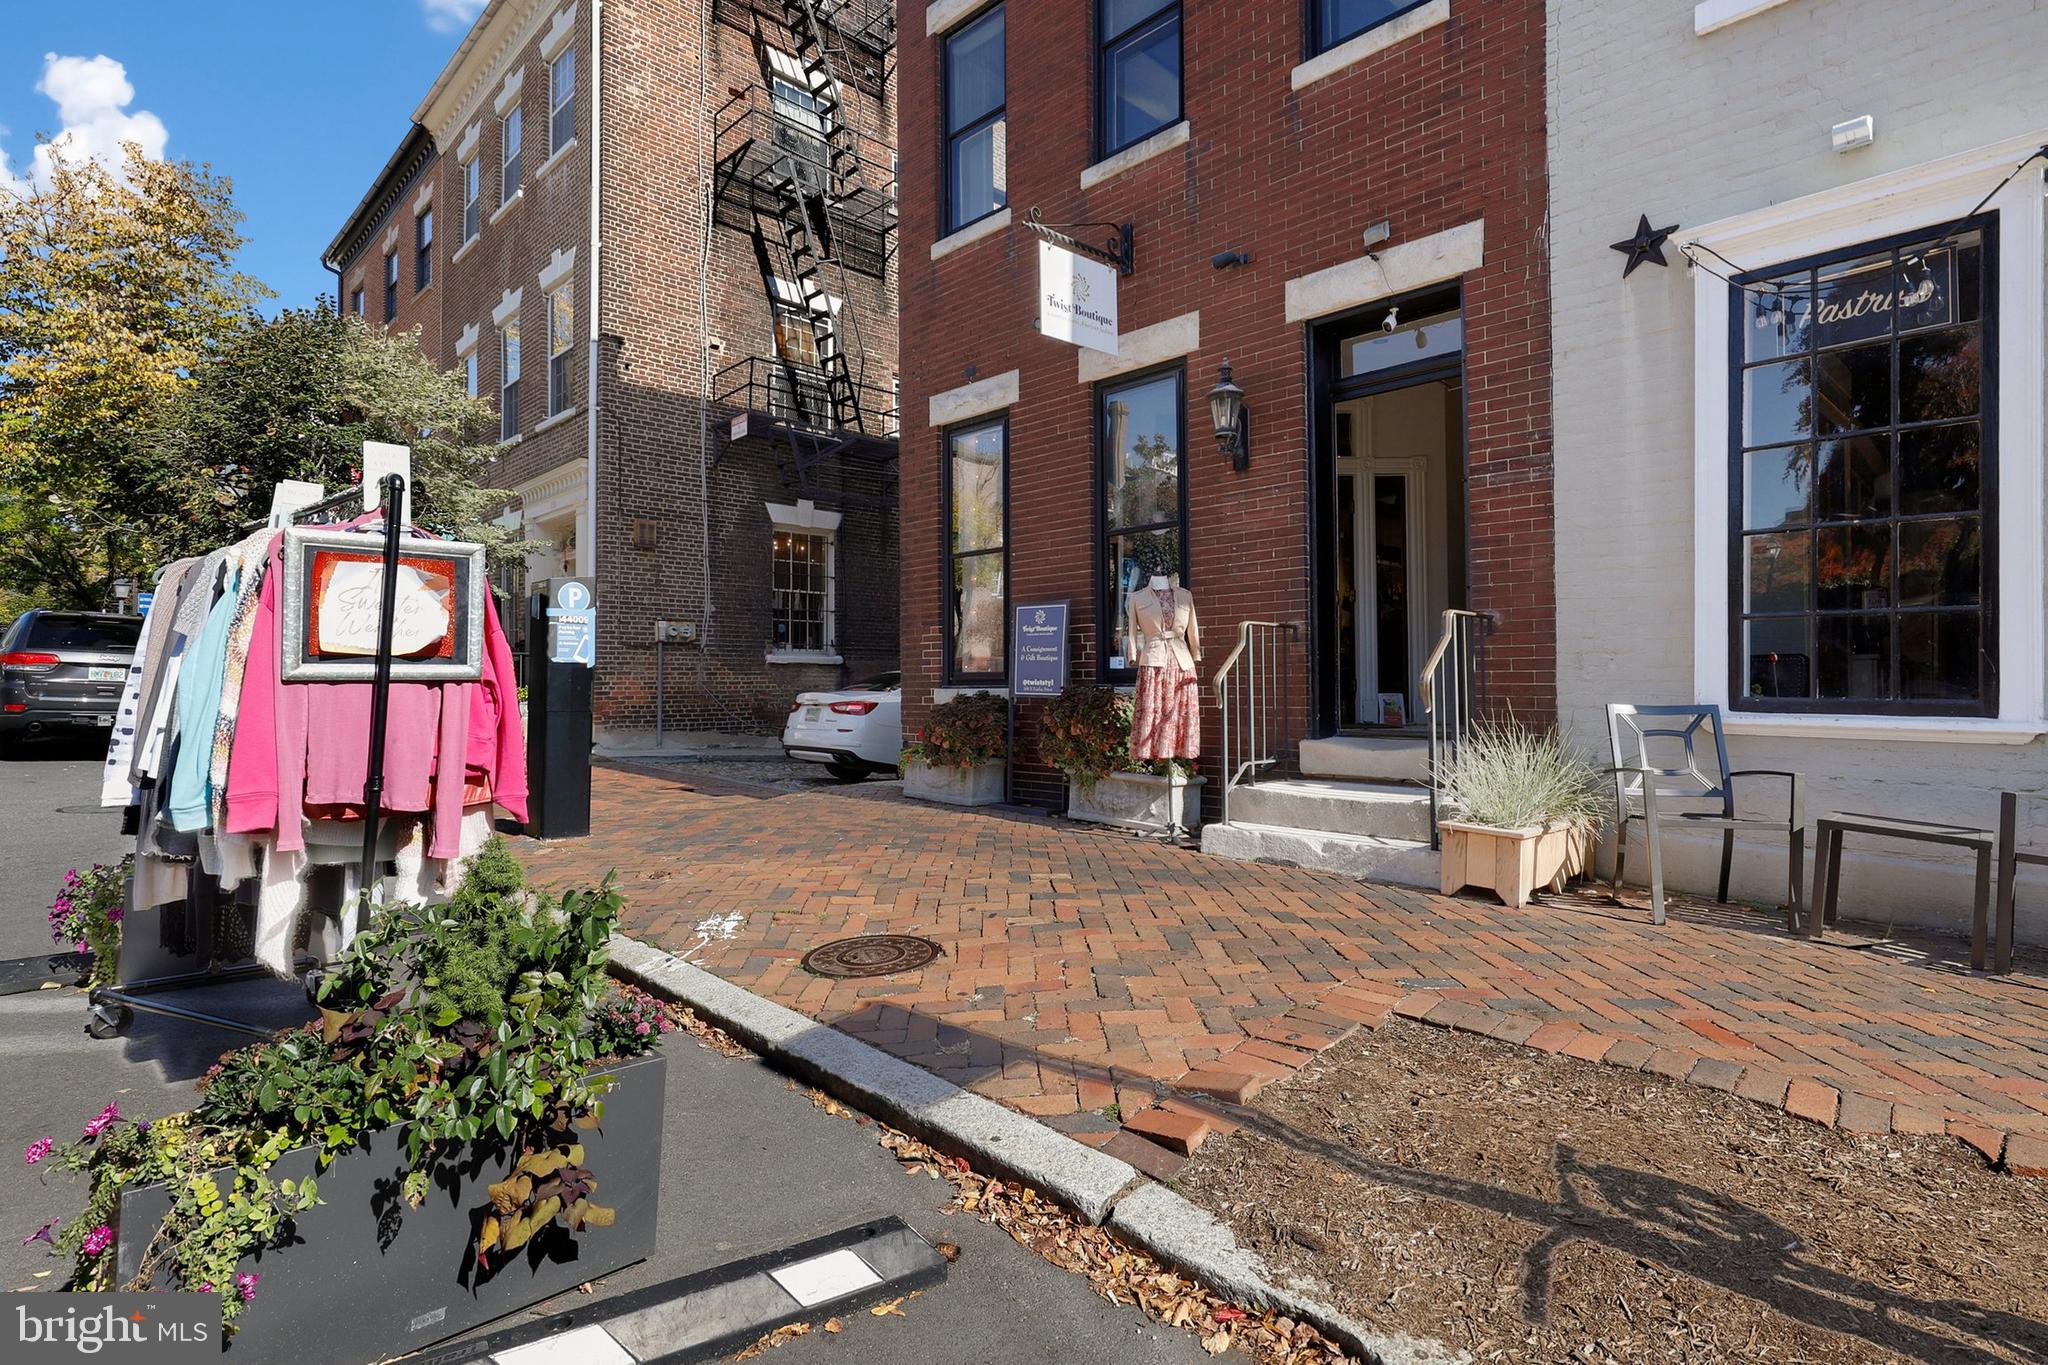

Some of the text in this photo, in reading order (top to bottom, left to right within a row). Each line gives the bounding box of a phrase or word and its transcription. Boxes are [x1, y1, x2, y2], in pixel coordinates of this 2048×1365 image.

[1047, 293, 1072, 313] Twist
[1072, 303, 1113, 326] Boutique
[1799, 288, 1934, 329] Pastri
[337, 585, 422, 615] Sweter
[568, 587, 582, 608] P
[336, 612, 419, 638] Weher
[1026, 645, 1058, 653] Consignment
[1026, 653, 1036, 661] Gift
[1036, 654, 1058, 663] Boutique
